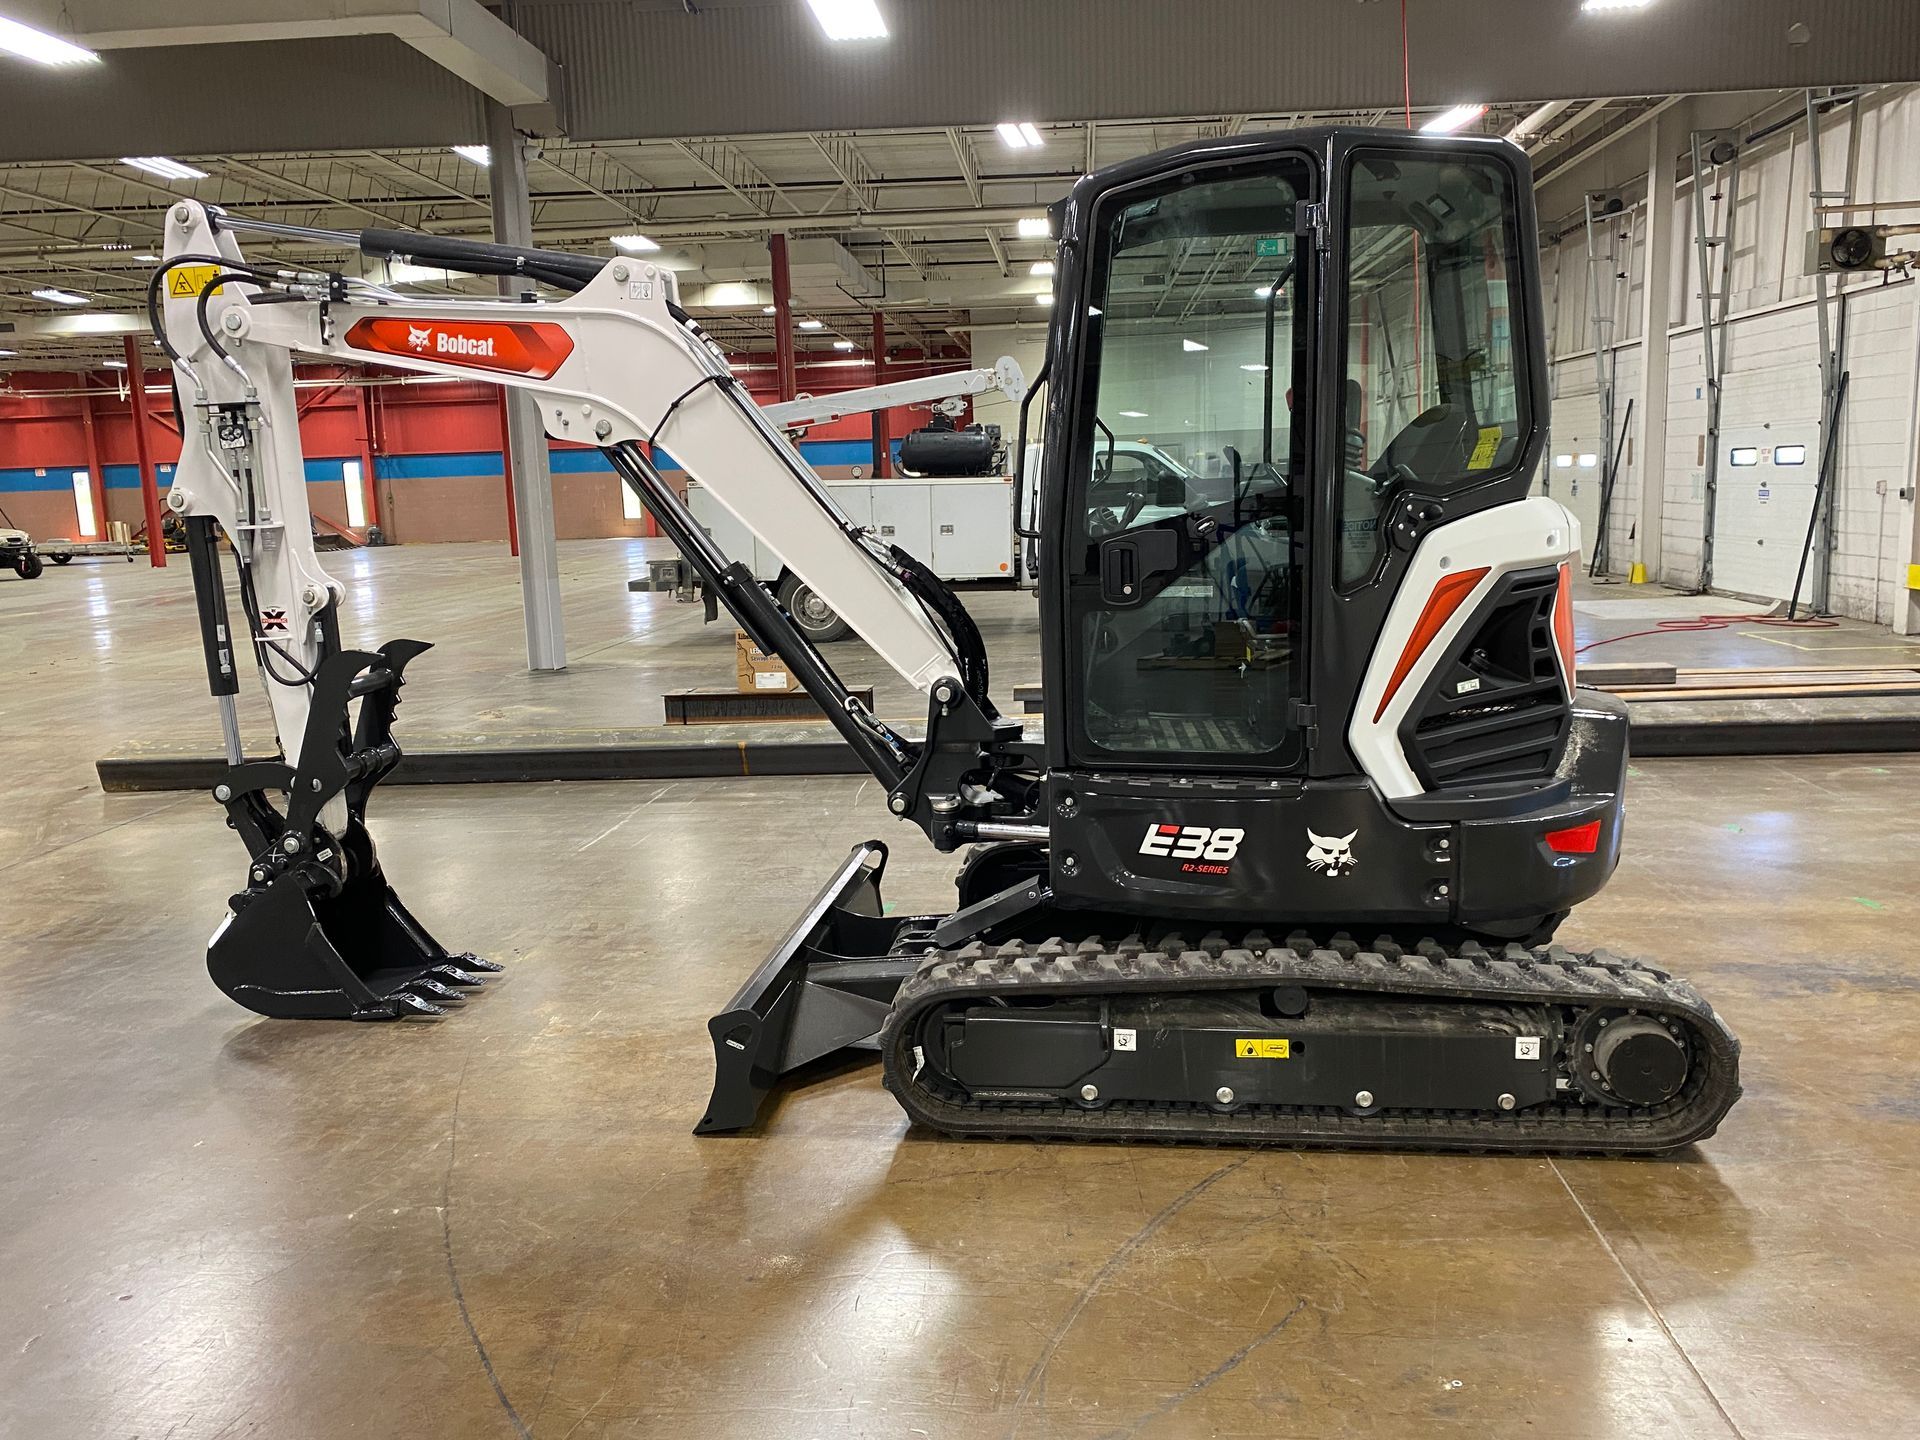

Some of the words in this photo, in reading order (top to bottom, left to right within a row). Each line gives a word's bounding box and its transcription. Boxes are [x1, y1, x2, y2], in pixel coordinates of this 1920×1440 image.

[437, 333, 494, 356] Bobcat
[1139, 823, 1245, 861] E38
[1182, 863, 1229, 875] R2-SERIES
